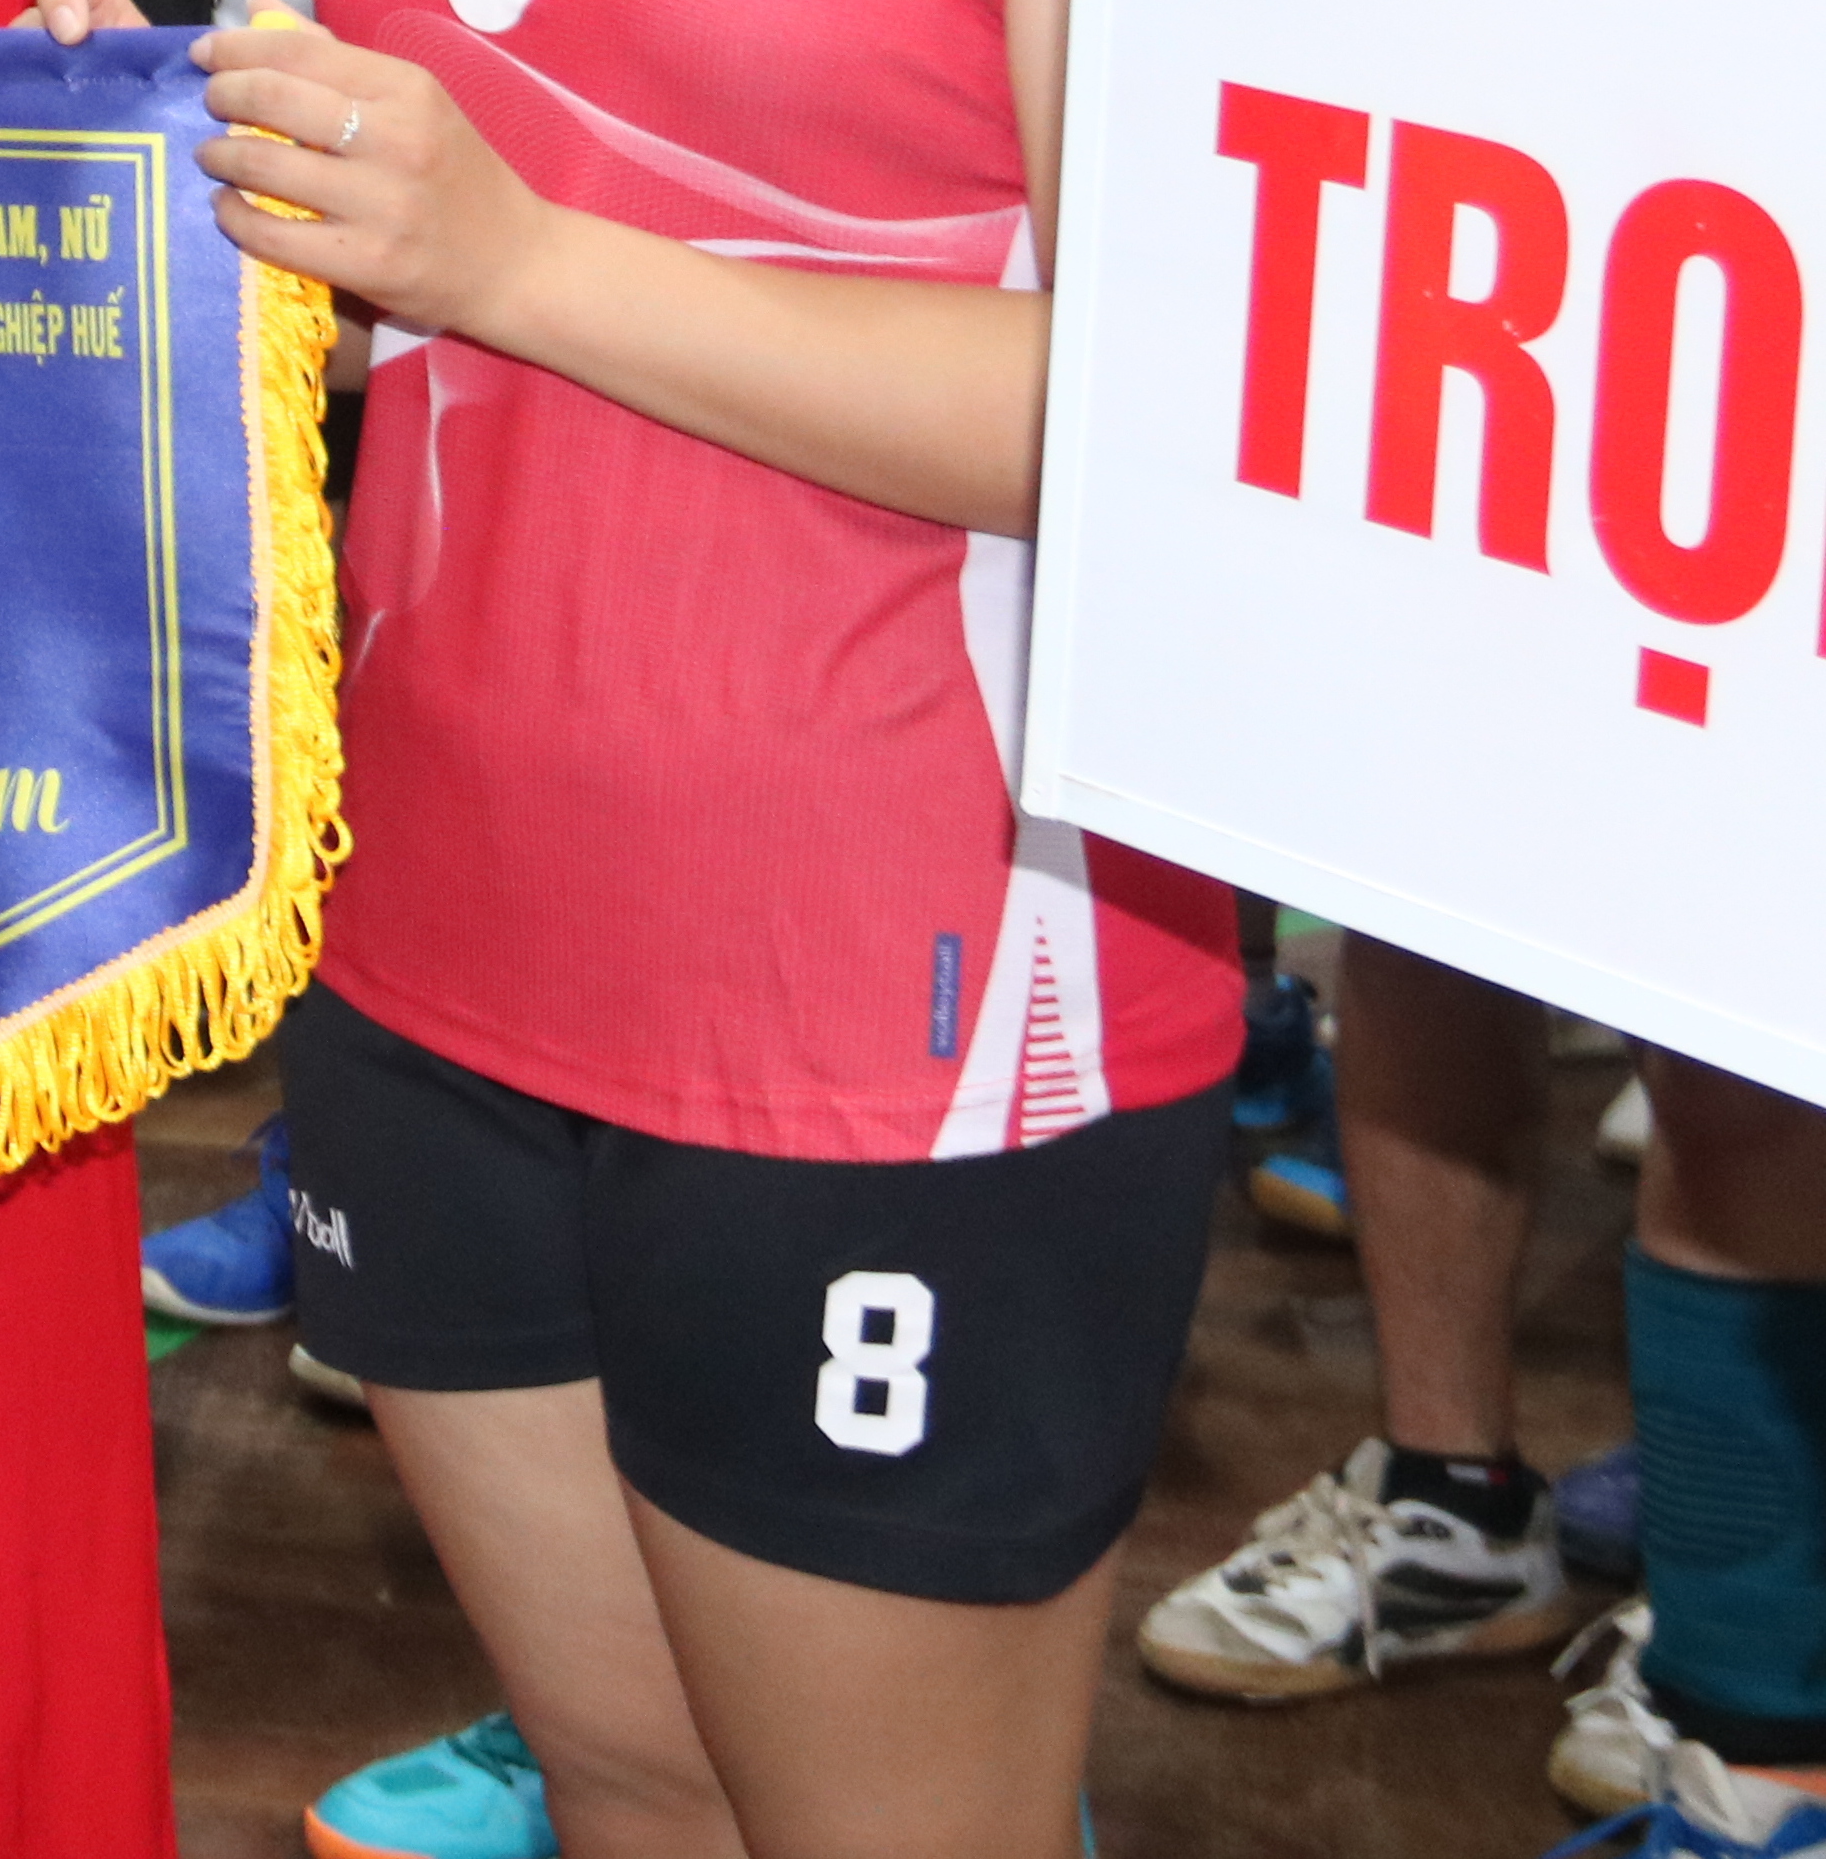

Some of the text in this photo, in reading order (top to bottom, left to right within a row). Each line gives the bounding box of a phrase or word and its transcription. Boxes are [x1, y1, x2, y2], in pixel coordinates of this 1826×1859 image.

[59, 193, 113, 261] NỮ
[71, 284, 125, 358] HUẾ
[1215, 79, 1826, 728] TRỌ
[813, 1270, 935, 1457] 8
